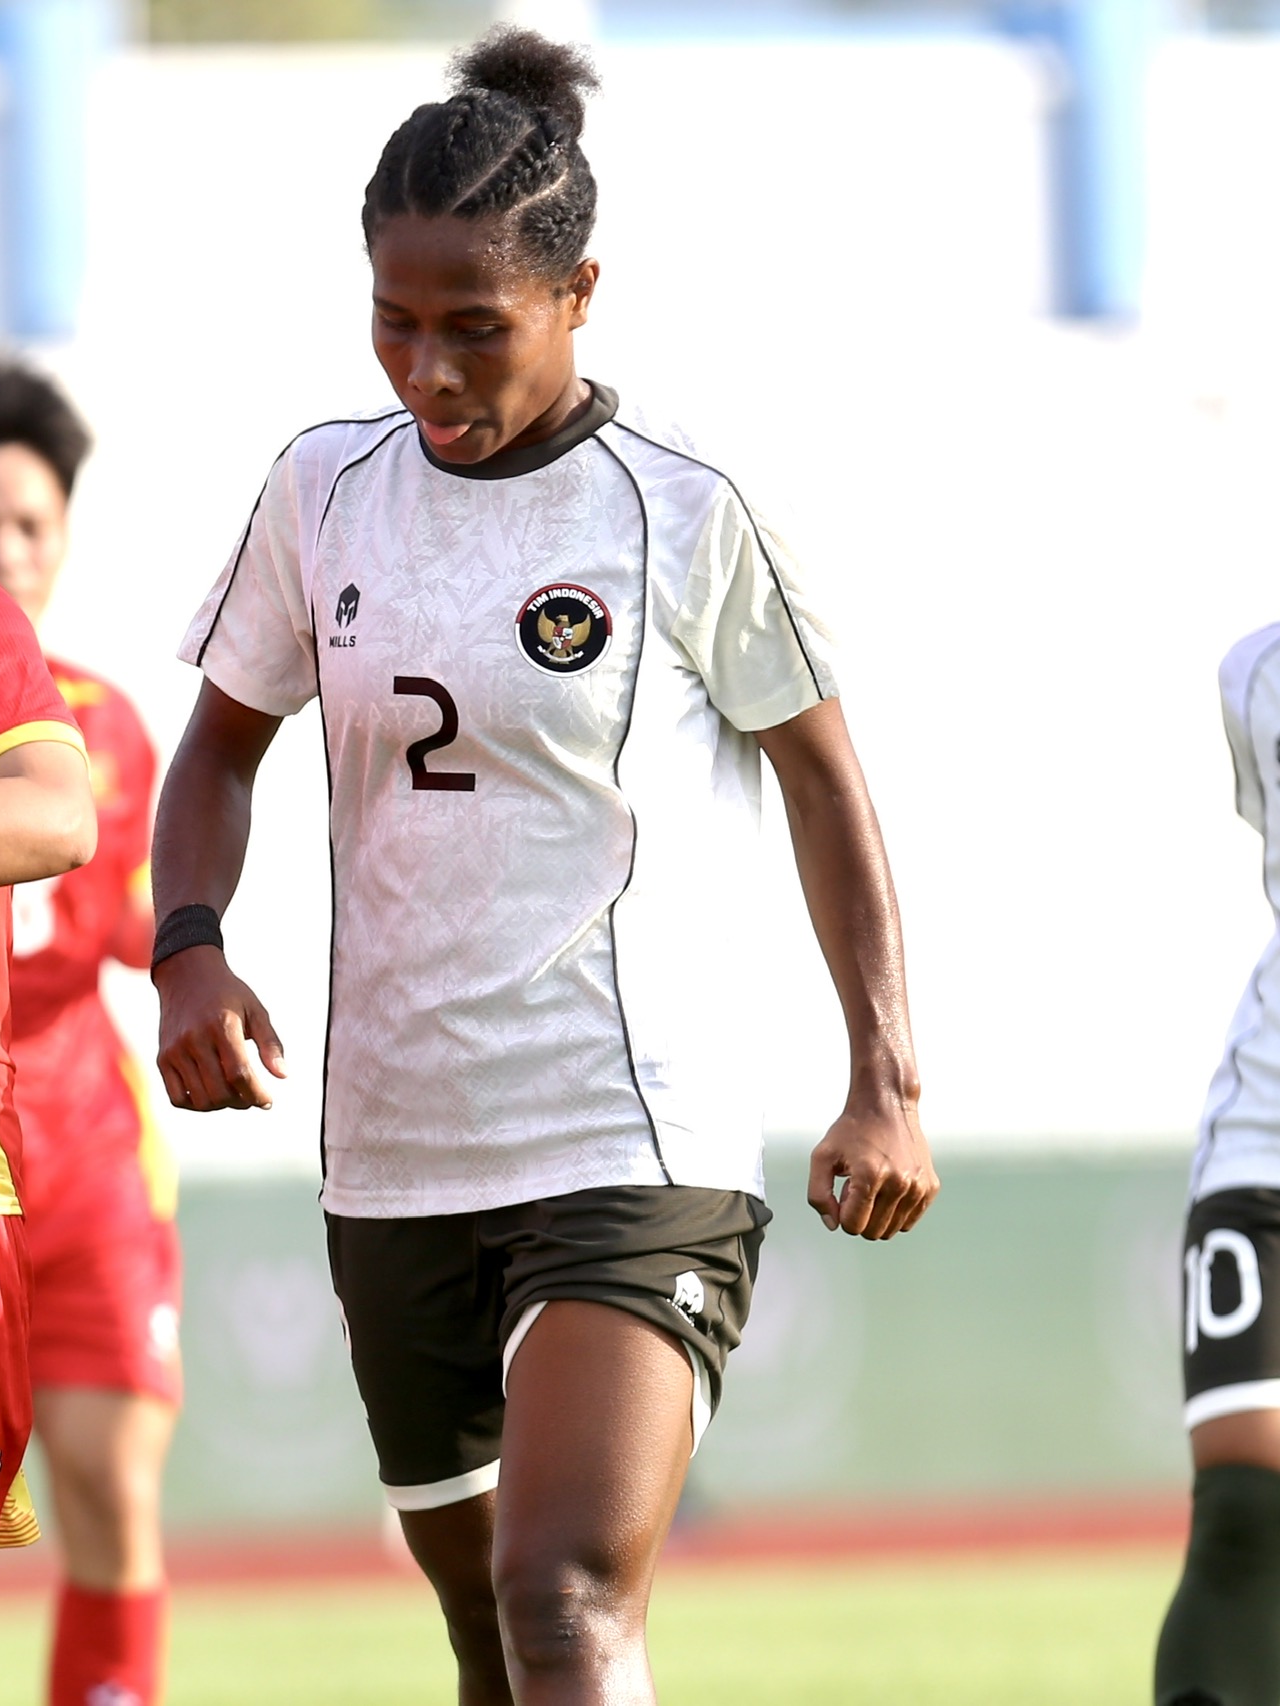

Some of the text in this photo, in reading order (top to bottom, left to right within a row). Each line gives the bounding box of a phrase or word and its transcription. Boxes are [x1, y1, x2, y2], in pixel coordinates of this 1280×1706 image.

[527, 588, 605, 620] TIM INDONESIA
[329, 635, 357, 648] MILLS
[393, 676, 476, 791] 2
[1185, 1228, 1262, 1355] 10
